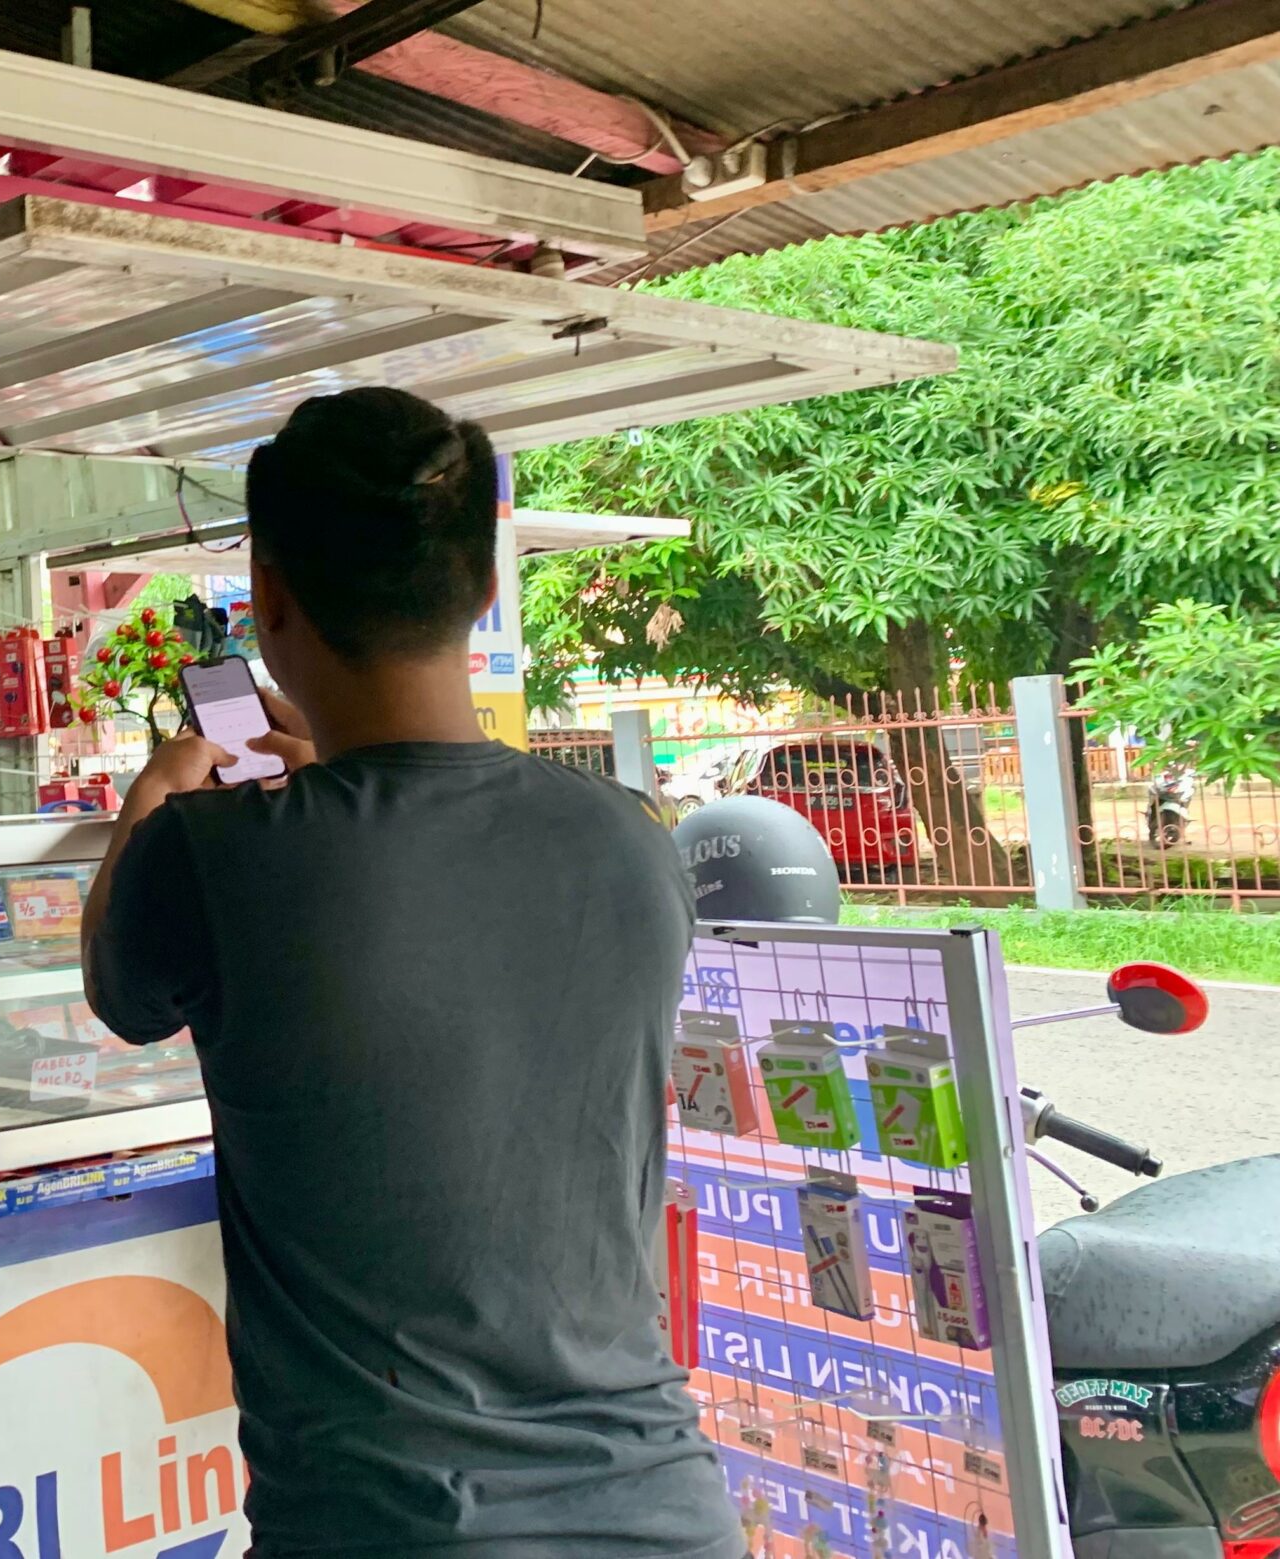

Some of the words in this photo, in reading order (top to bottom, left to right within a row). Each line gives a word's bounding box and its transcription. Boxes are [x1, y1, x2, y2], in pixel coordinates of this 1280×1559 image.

[771, 867, 817, 875] HONDA
[1056, 1379, 1108, 1407] GEOFF
[1111, 1380, 1153, 1408] MAX
[101, 1434, 252, 1554] Lin
